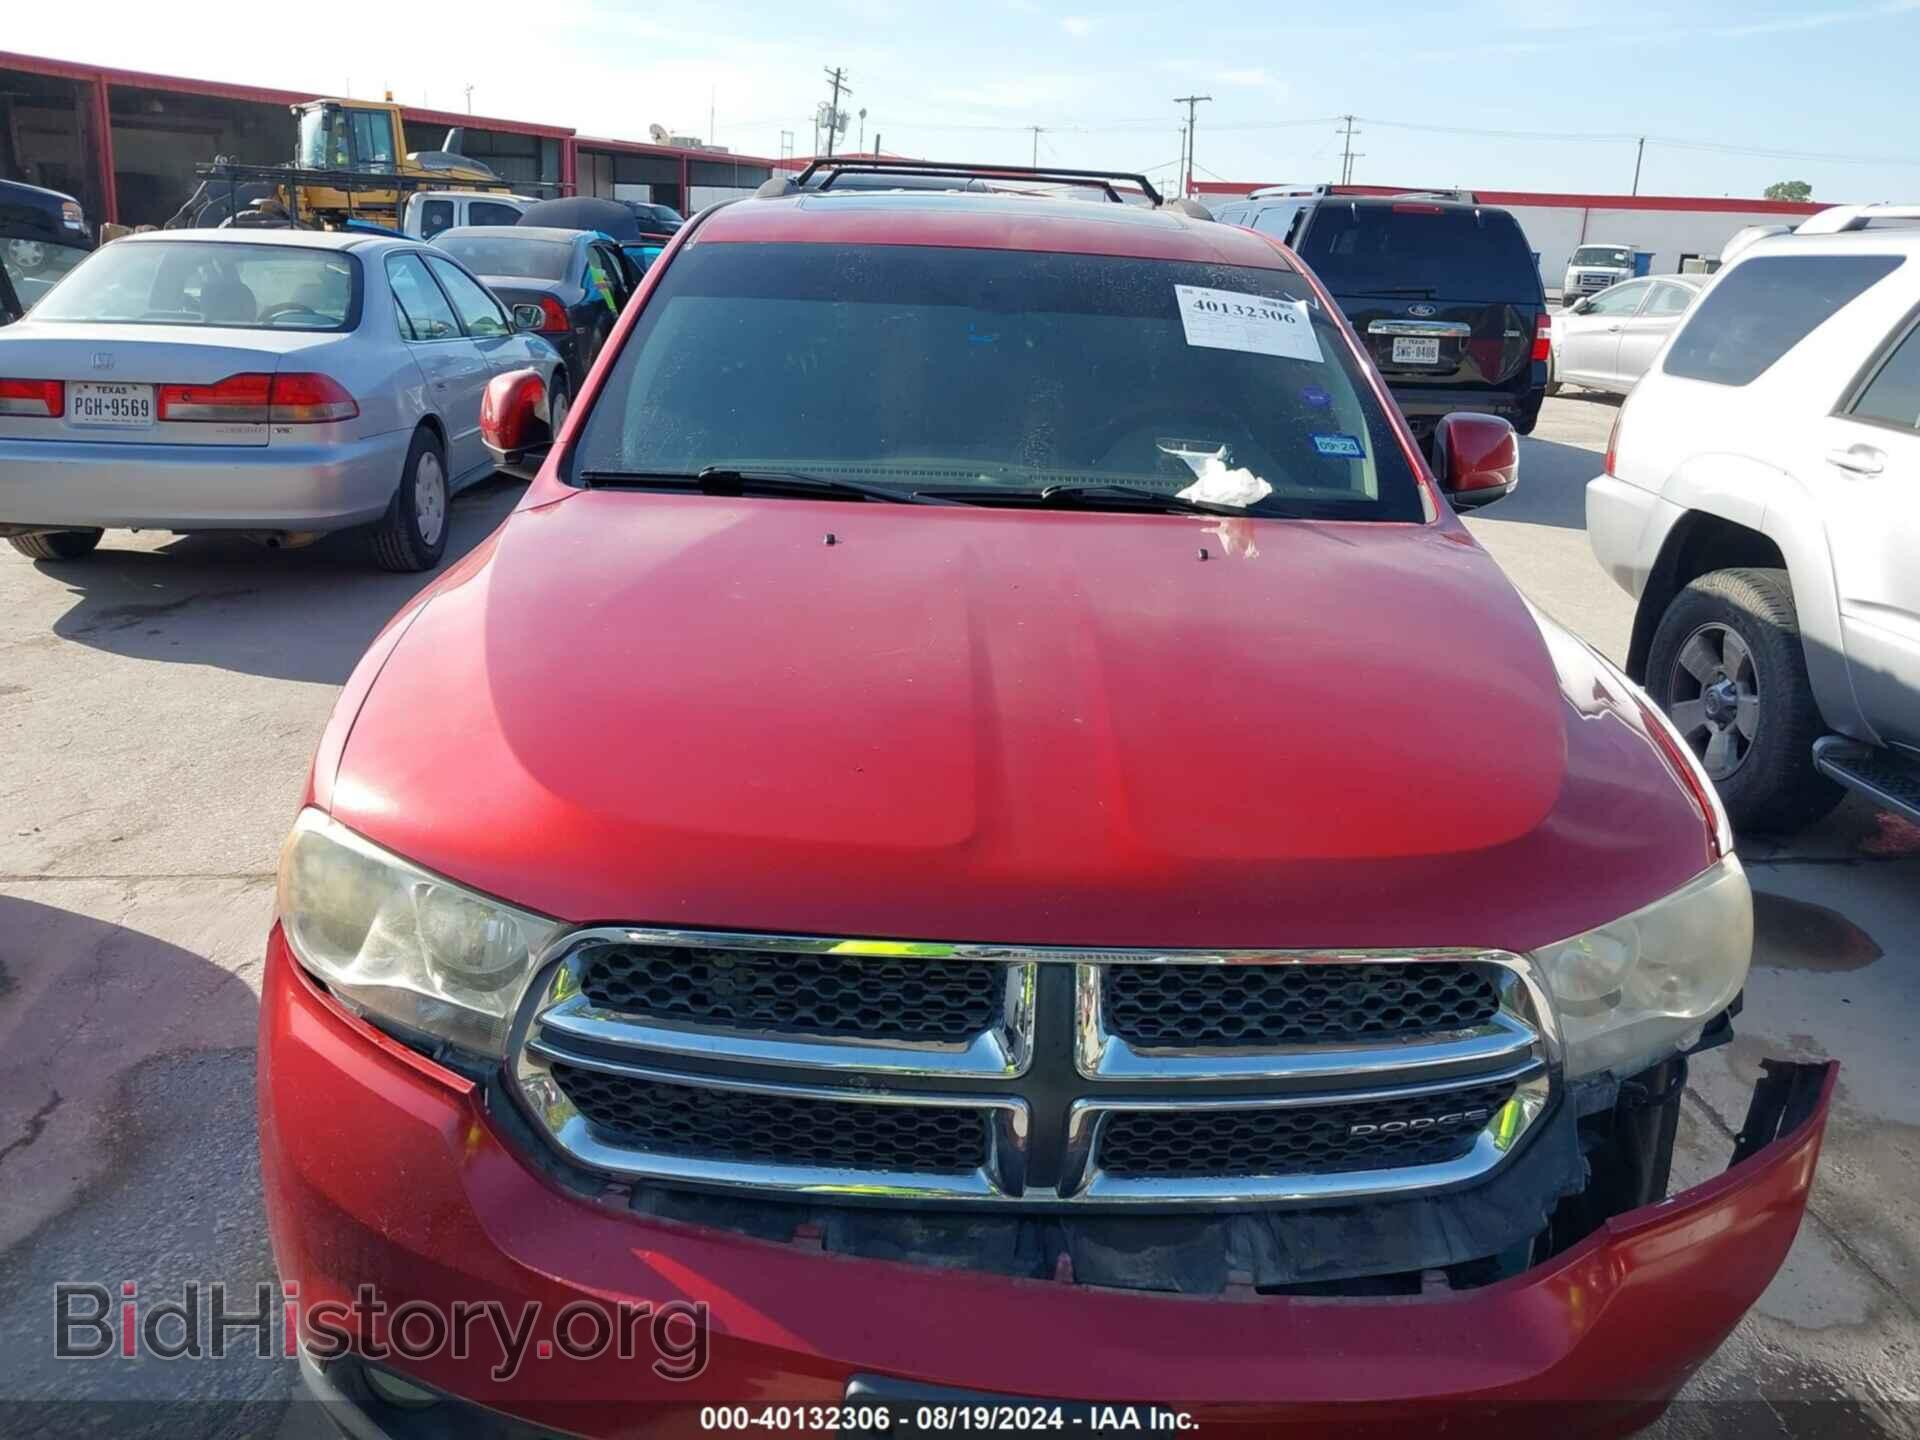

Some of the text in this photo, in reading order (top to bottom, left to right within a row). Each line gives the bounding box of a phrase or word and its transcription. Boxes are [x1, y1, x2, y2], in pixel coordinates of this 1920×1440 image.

[1193, 299, 1296, 324] 40132306
[96, 386, 127, 394] TEXAS
[75, 397, 149, 416] PGH-9569
[1350, 1108, 1488, 1135] DODGE
